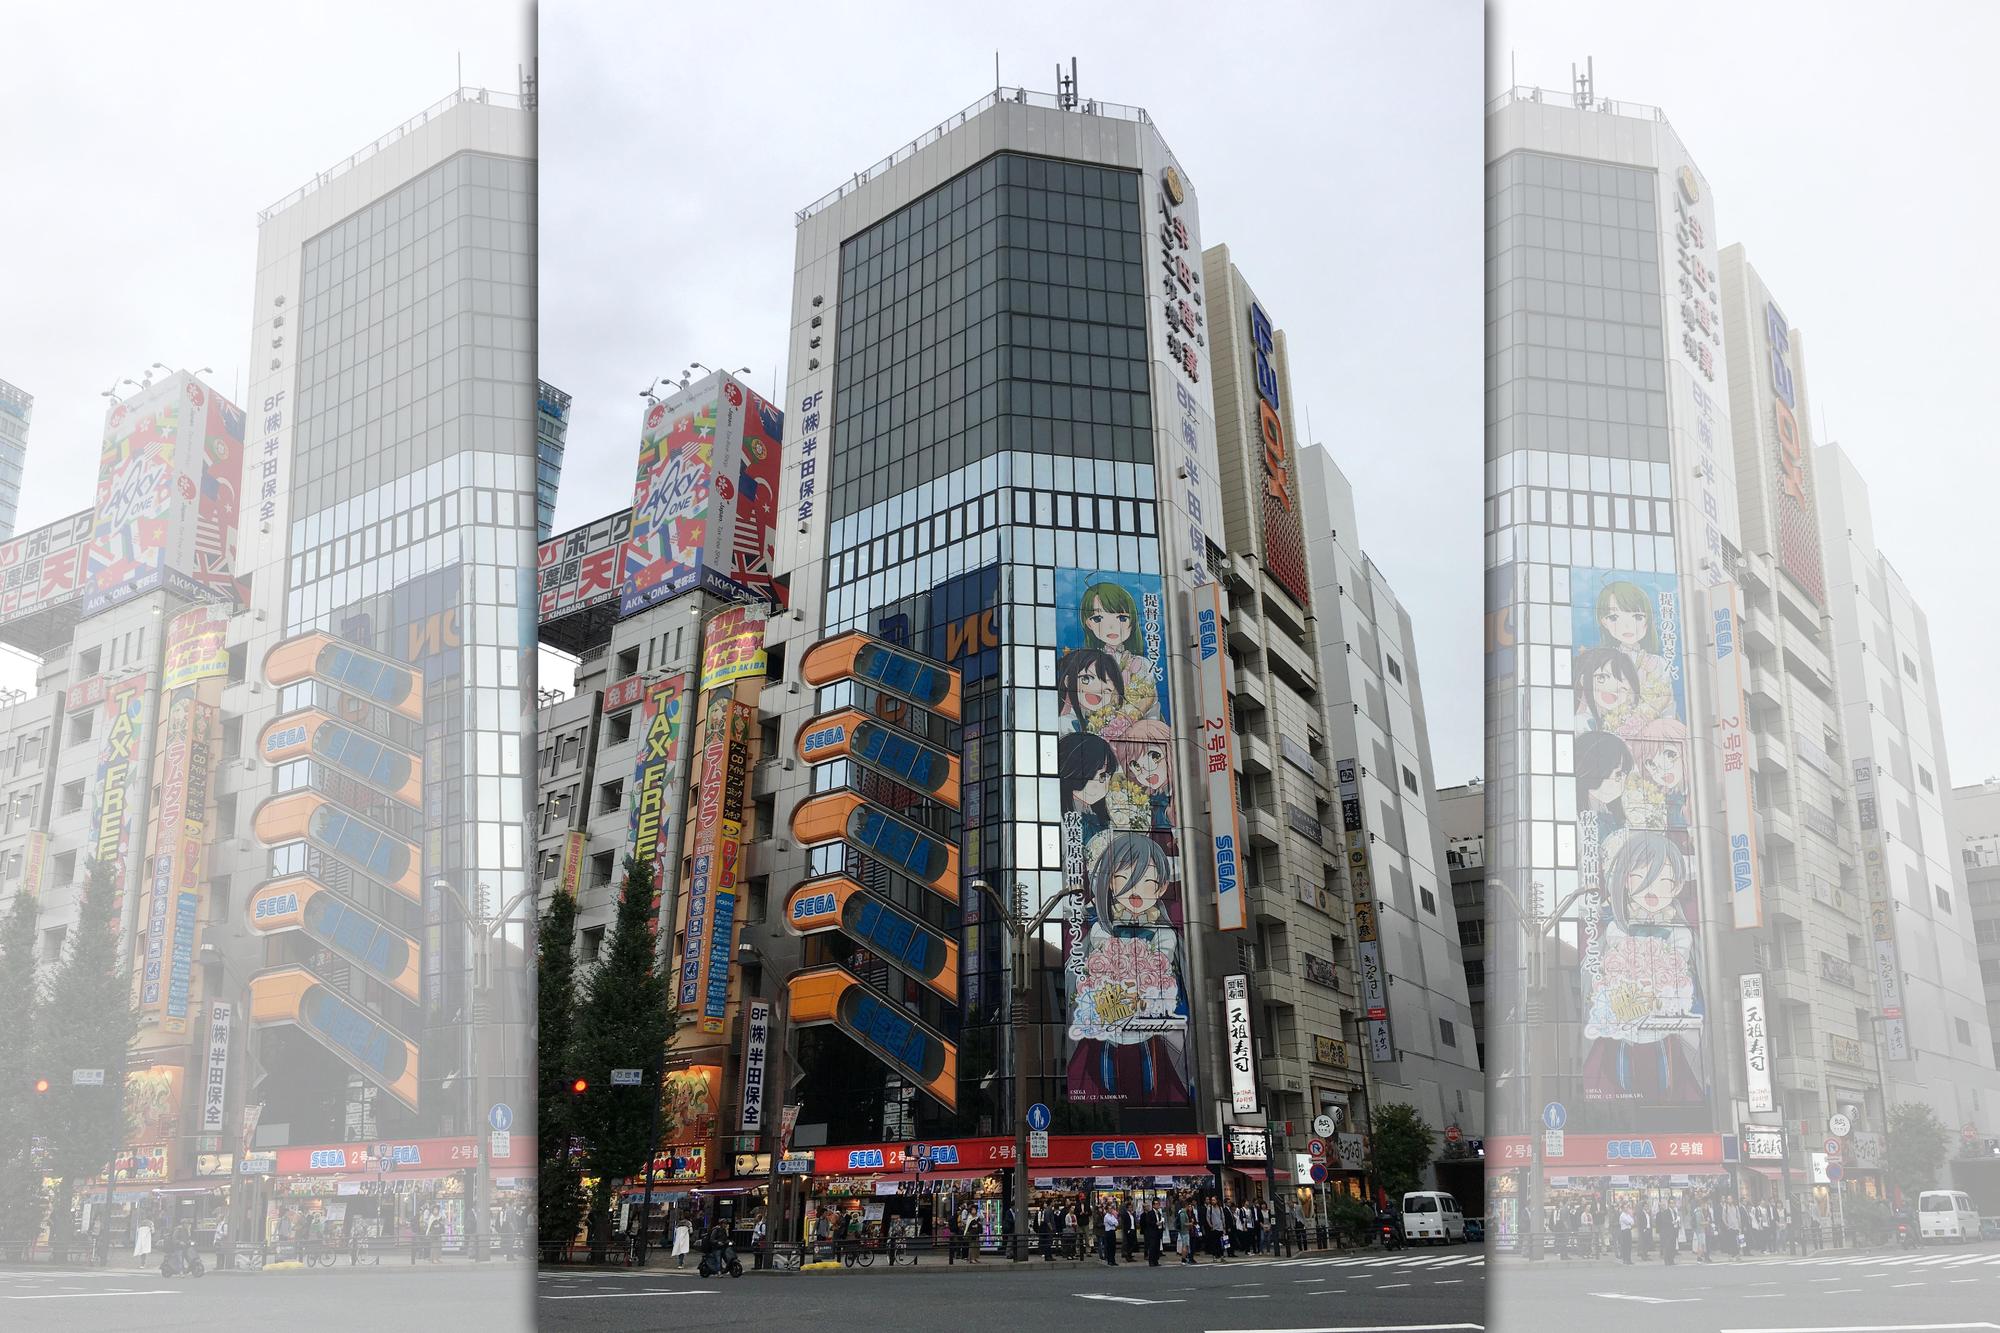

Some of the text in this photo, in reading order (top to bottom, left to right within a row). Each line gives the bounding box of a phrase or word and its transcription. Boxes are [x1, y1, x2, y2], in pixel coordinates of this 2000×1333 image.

[264, 390, 285, 412] 8F
[1176, 381, 1196, 412] 8F
[798, 390, 823, 521] 8F (株)半田保全
[667, 495, 693, 516] ONE
[706, 573, 737, 596] AKKY
[1143, 594, 1163, 681] 提督の皆さん、
[1199, 608, 1218, 661] SEGA
[1659, 593, 1679, 680] 提督の皆さん、
[1715, 607, 1734, 660] SEGA
[737, 661, 766, 672] AKIBA
[608, 682, 638, 707] 免税
[108, 688, 136, 761] TAX
[267, 724, 307, 753] SEGA
[805, 724, 845, 753] SEGA
[730, 742, 747, 755] ゲーム
[1205, 717, 1229, 774] 2号館
[1721, 716, 1745, 773] 2号館
[193, 754, 206, 765] CD
[731, 754, 744, 765] CD
[162, 742, 186, 829] ラムタラ
[635, 688, 674, 862] TAX FREE
[700, 742, 724, 829] ラムタラ
[727, 775, 745, 787] アニメ
[719, 838, 738, 888] DVD
[1215, 834, 1236, 895] SEGA
[1731, 833, 1752, 894] SEGA
[255, 893, 298, 919] SEGA
[793, 893, 836, 919] SEGA
[1106, 1014, 1174, 1032] Arcade
[1622, 1013, 1690, 1031] Arcade
[1230, 1006, 1249, 1073] 元祖寿司
[1746, 1005, 1765, 1072] 元祖寿司
[205, 1007, 230, 1125] 8F (株)半田保全
[743, 1007, 768, 1125] 8F (株)半田保全
[310, 1149, 346, 1169] SEGA
[392, 1144, 422, 1165] EGA
[848, 1149, 884, 1169] SEGA
[930, 1144, 960, 1165] EGA
[1090, 1140, 1188, 1161] SEGA 2号館
[1606, 1139, 1704, 1160] SEGA 2号館
